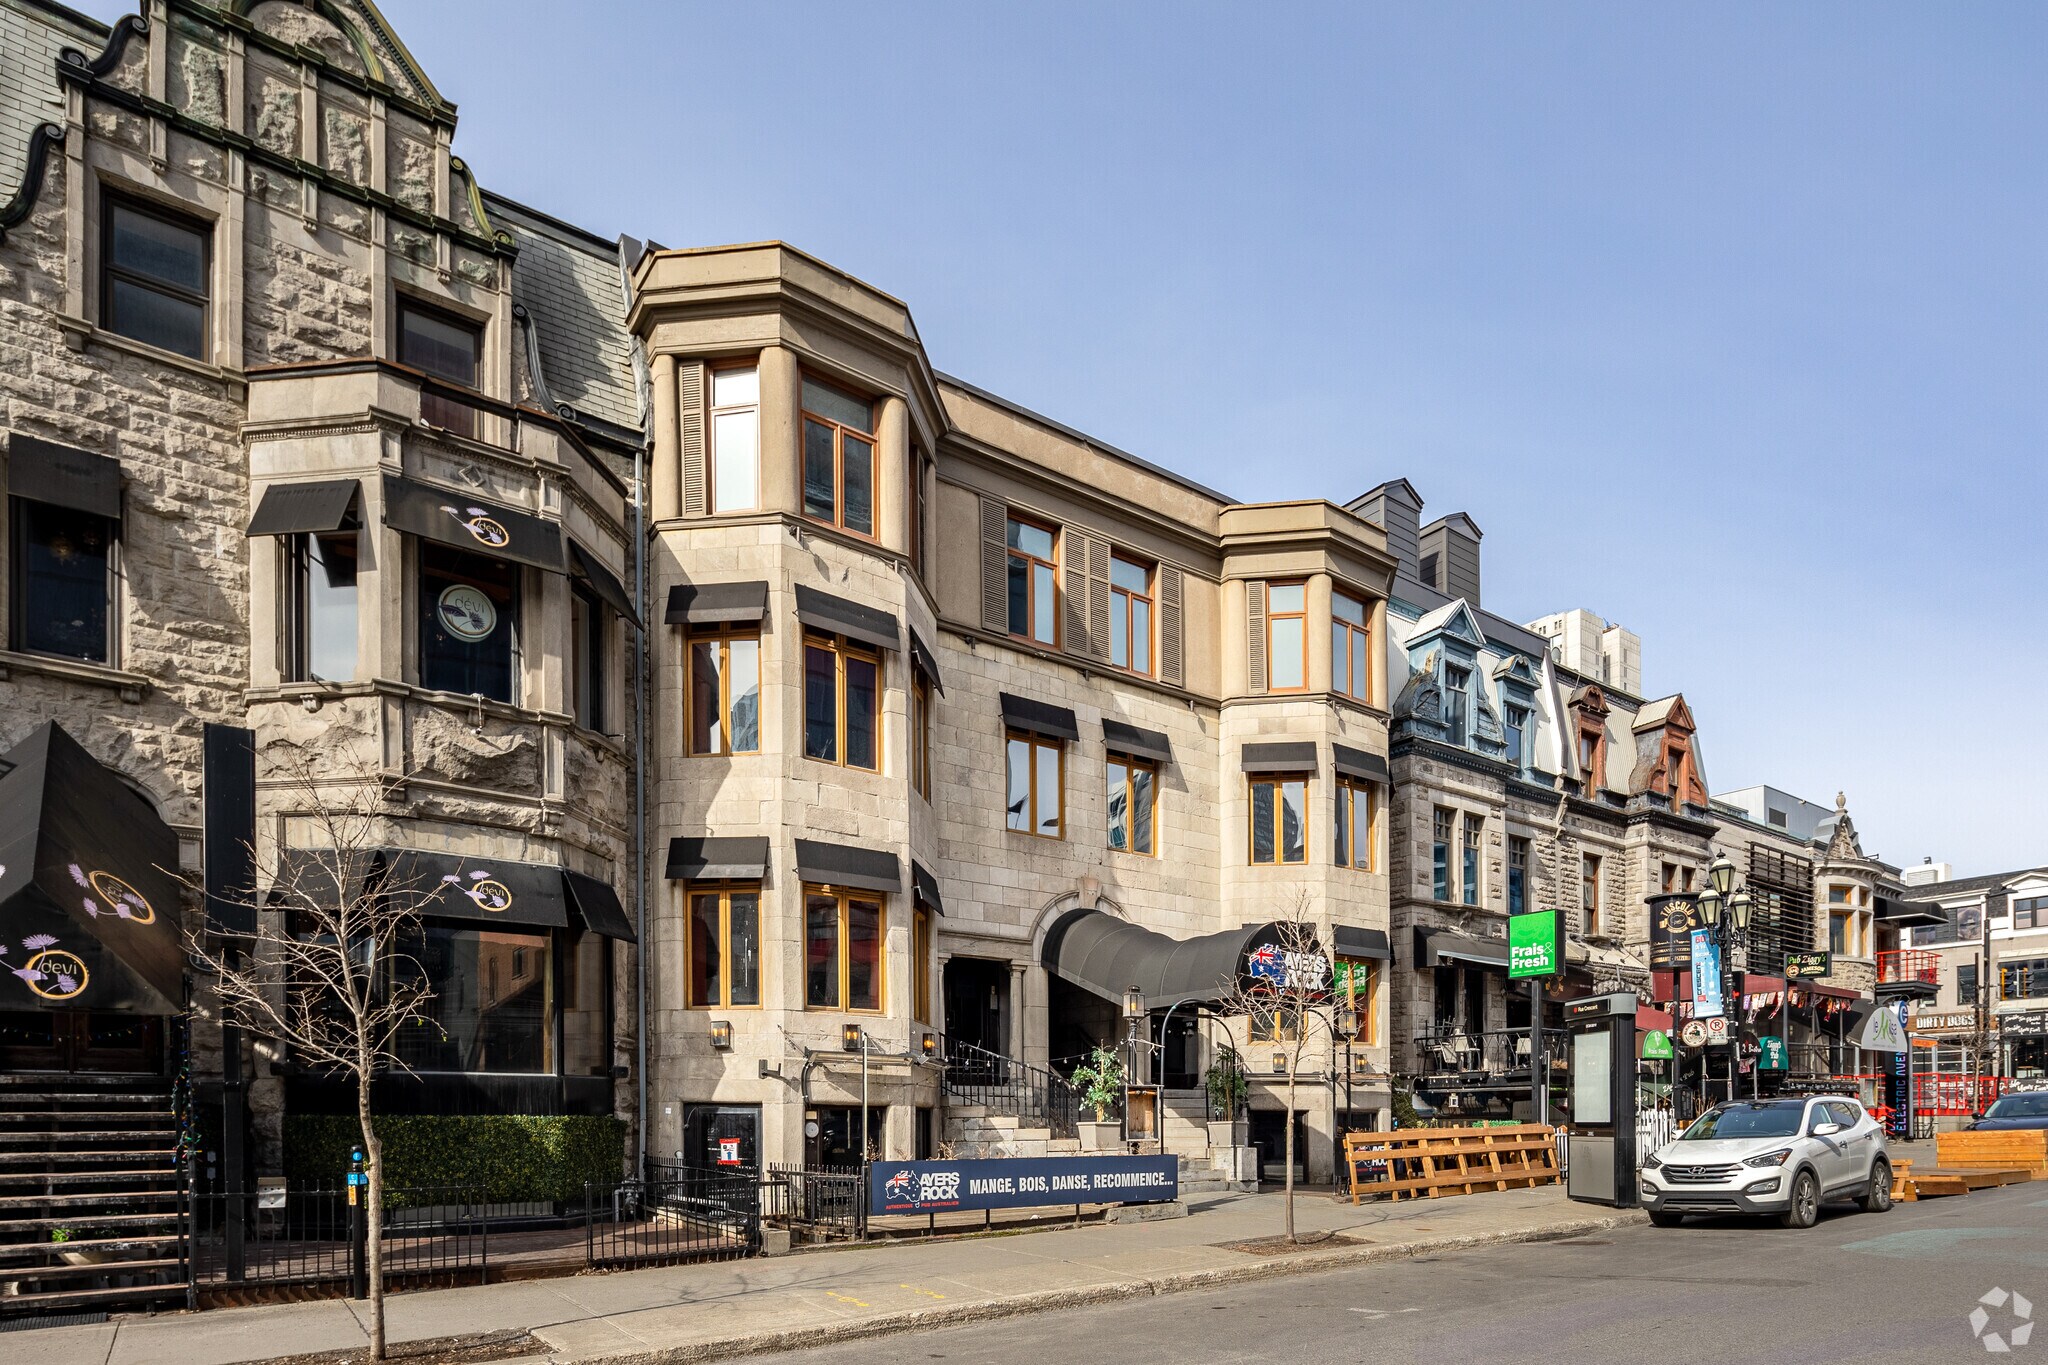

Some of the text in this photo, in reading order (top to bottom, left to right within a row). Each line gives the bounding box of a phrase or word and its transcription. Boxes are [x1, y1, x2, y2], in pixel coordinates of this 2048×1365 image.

[1660, 901, 1695, 917] TUSCOLO
[41, 959, 77, 975] devi
[1511, 955, 1549, 970] Fresh
[1787, 953, 1827, 966] Pub Ziggy's
[1800, 965, 1825, 973] JAMESON
[1916, 1014, 1975, 1029] DIRTY DOGS
[1895, 1080, 1907, 1131] ELECTRIC
[920, 1172, 960, 1187] AYERS
[969, 1172, 1174, 1195] MANGE, BOIS, DANSE, RECOMMENCE...
[920, 1185, 960, 1201] ROCK
